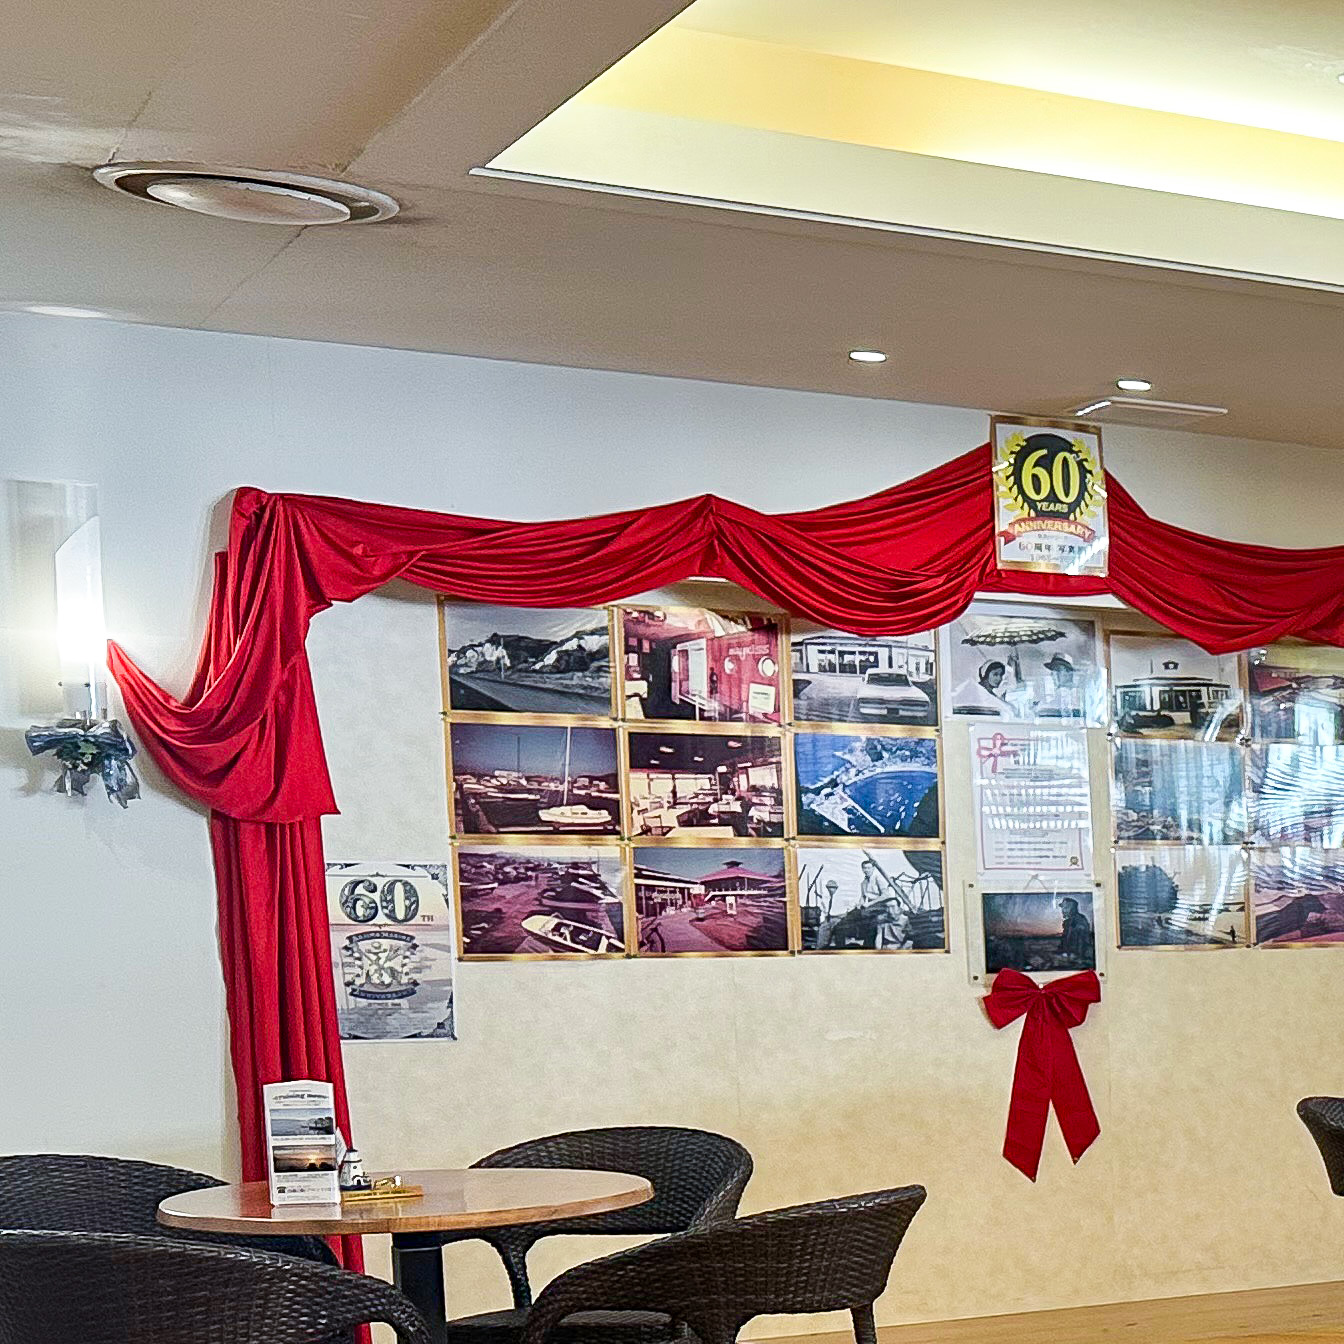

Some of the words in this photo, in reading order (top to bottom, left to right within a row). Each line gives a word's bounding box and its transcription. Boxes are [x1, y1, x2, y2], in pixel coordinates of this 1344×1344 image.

[1021, 449, 1080, 504] 60
[1035, 501, 1069, 513] YEARS
[1013, 519, 1093, 541] ANNIVERSARY
[339, 878, 420, 924] 60
[420, 914, 434, 922] TH
